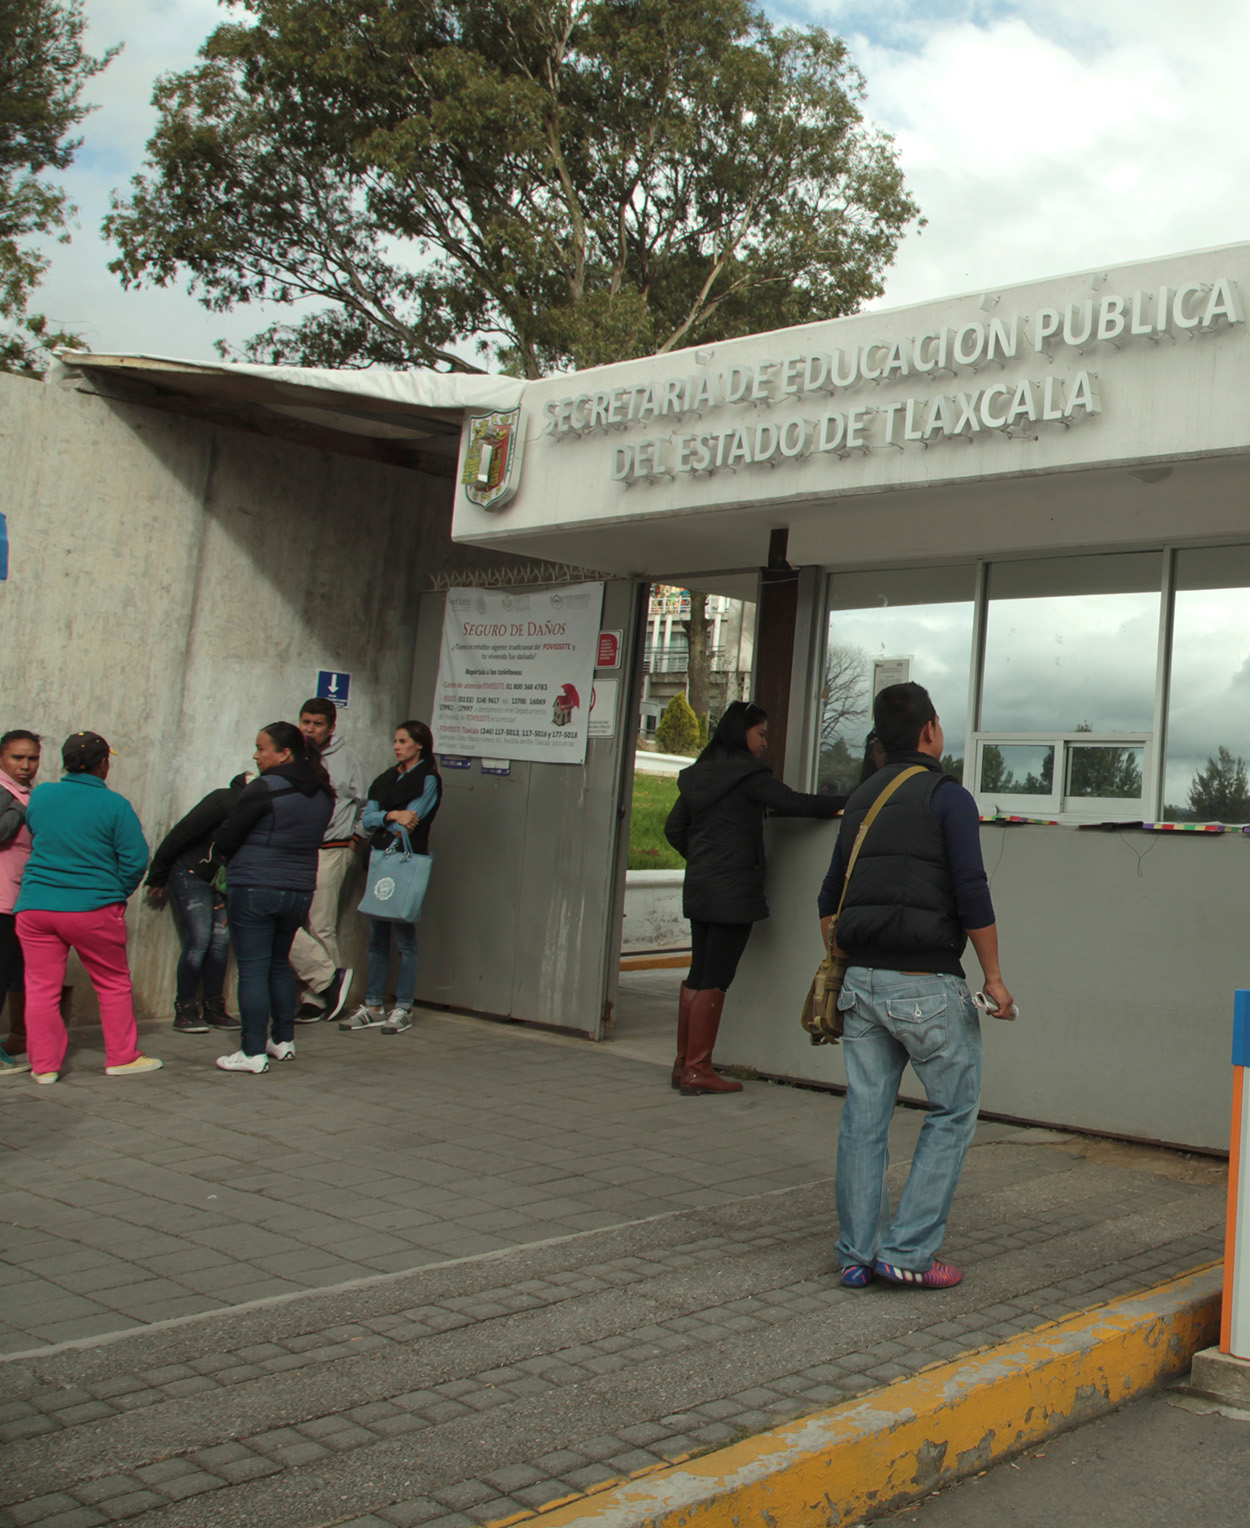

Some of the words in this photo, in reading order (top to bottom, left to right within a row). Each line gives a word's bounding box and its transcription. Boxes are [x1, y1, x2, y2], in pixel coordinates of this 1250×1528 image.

[724, 359, 771, 403] DE
[611, 437, 666, 481] DEL
[675, 417, 806, 472] ESTADO
[819, 406, 867, 452] DE
[884, 370, 1097, 443] TLAXCALA
[463, 621, 507, 637] SEGURO
[510, 624, 523, 637] DE
